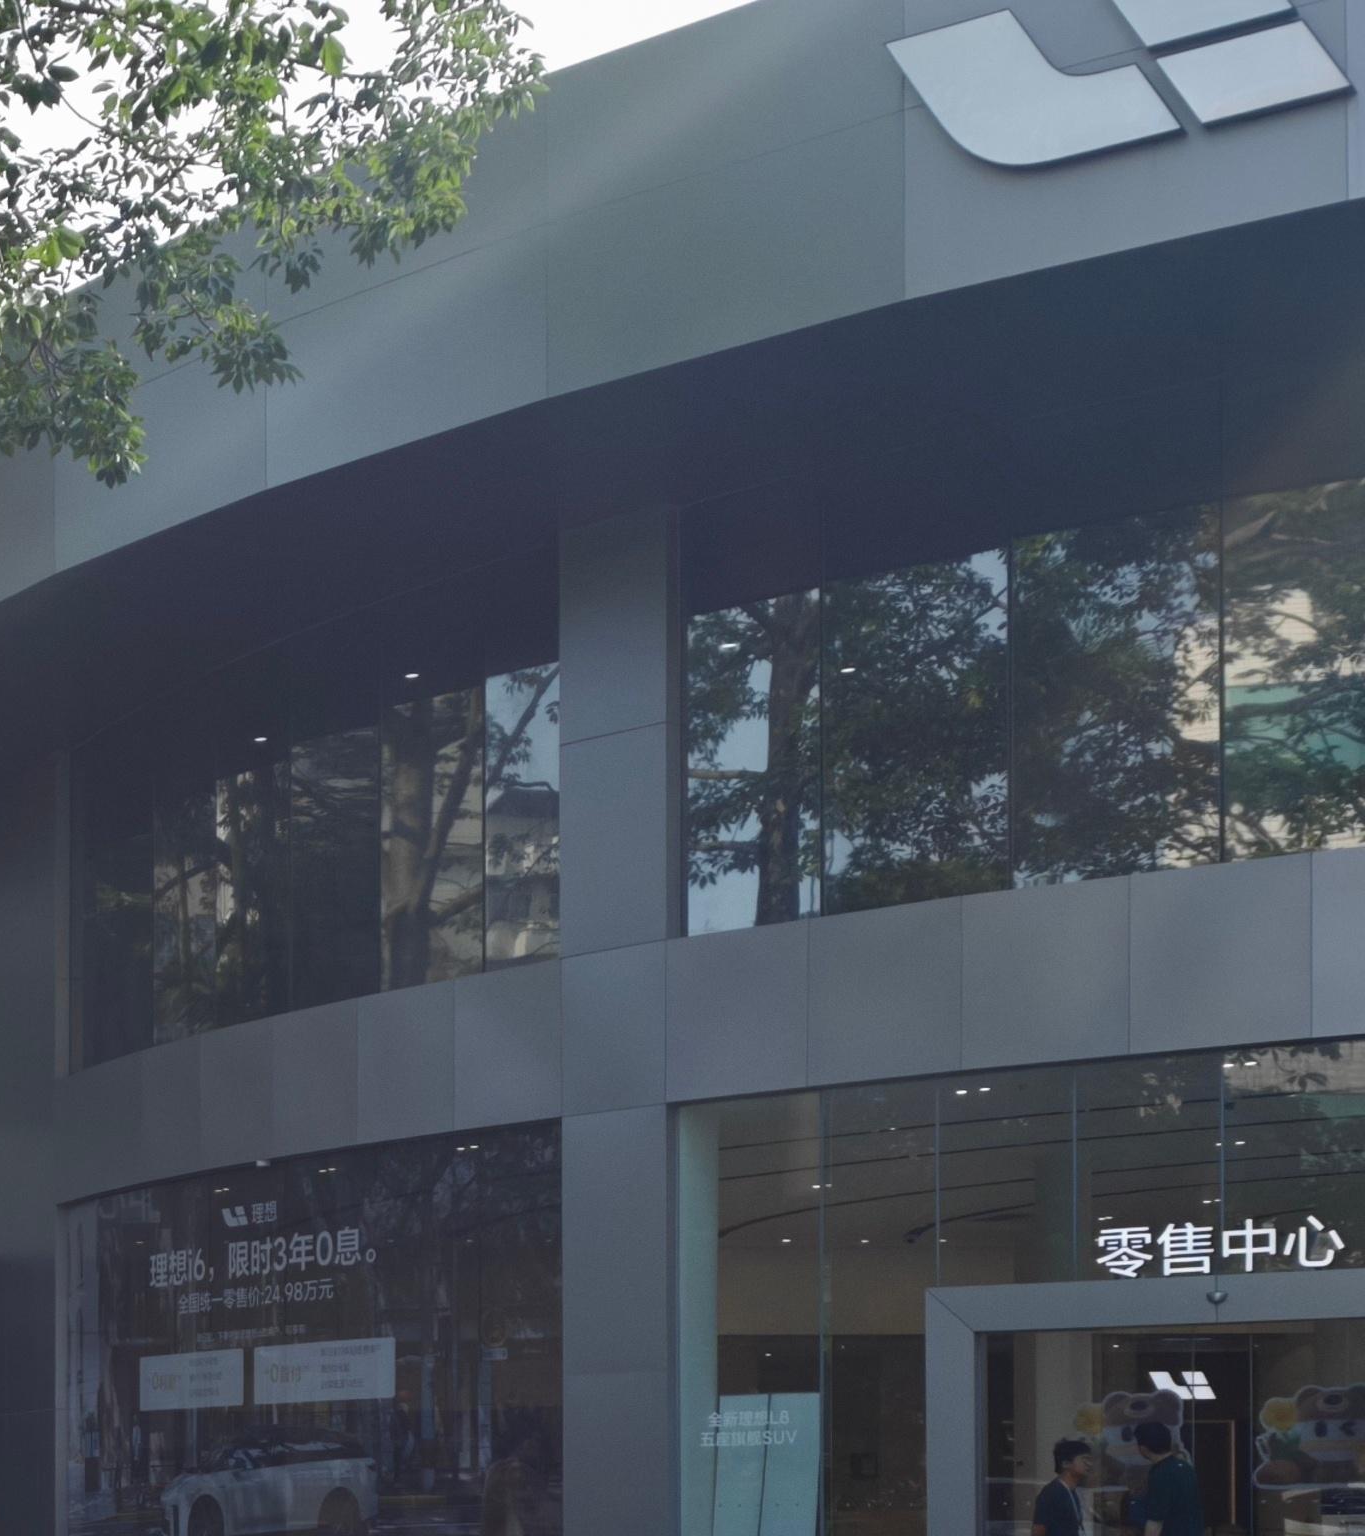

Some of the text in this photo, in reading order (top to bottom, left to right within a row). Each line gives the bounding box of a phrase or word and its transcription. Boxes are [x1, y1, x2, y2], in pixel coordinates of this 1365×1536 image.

[251, 1201, 277, 1224] 理想
[1096, 1215, 1345, 1278] 零售中心
